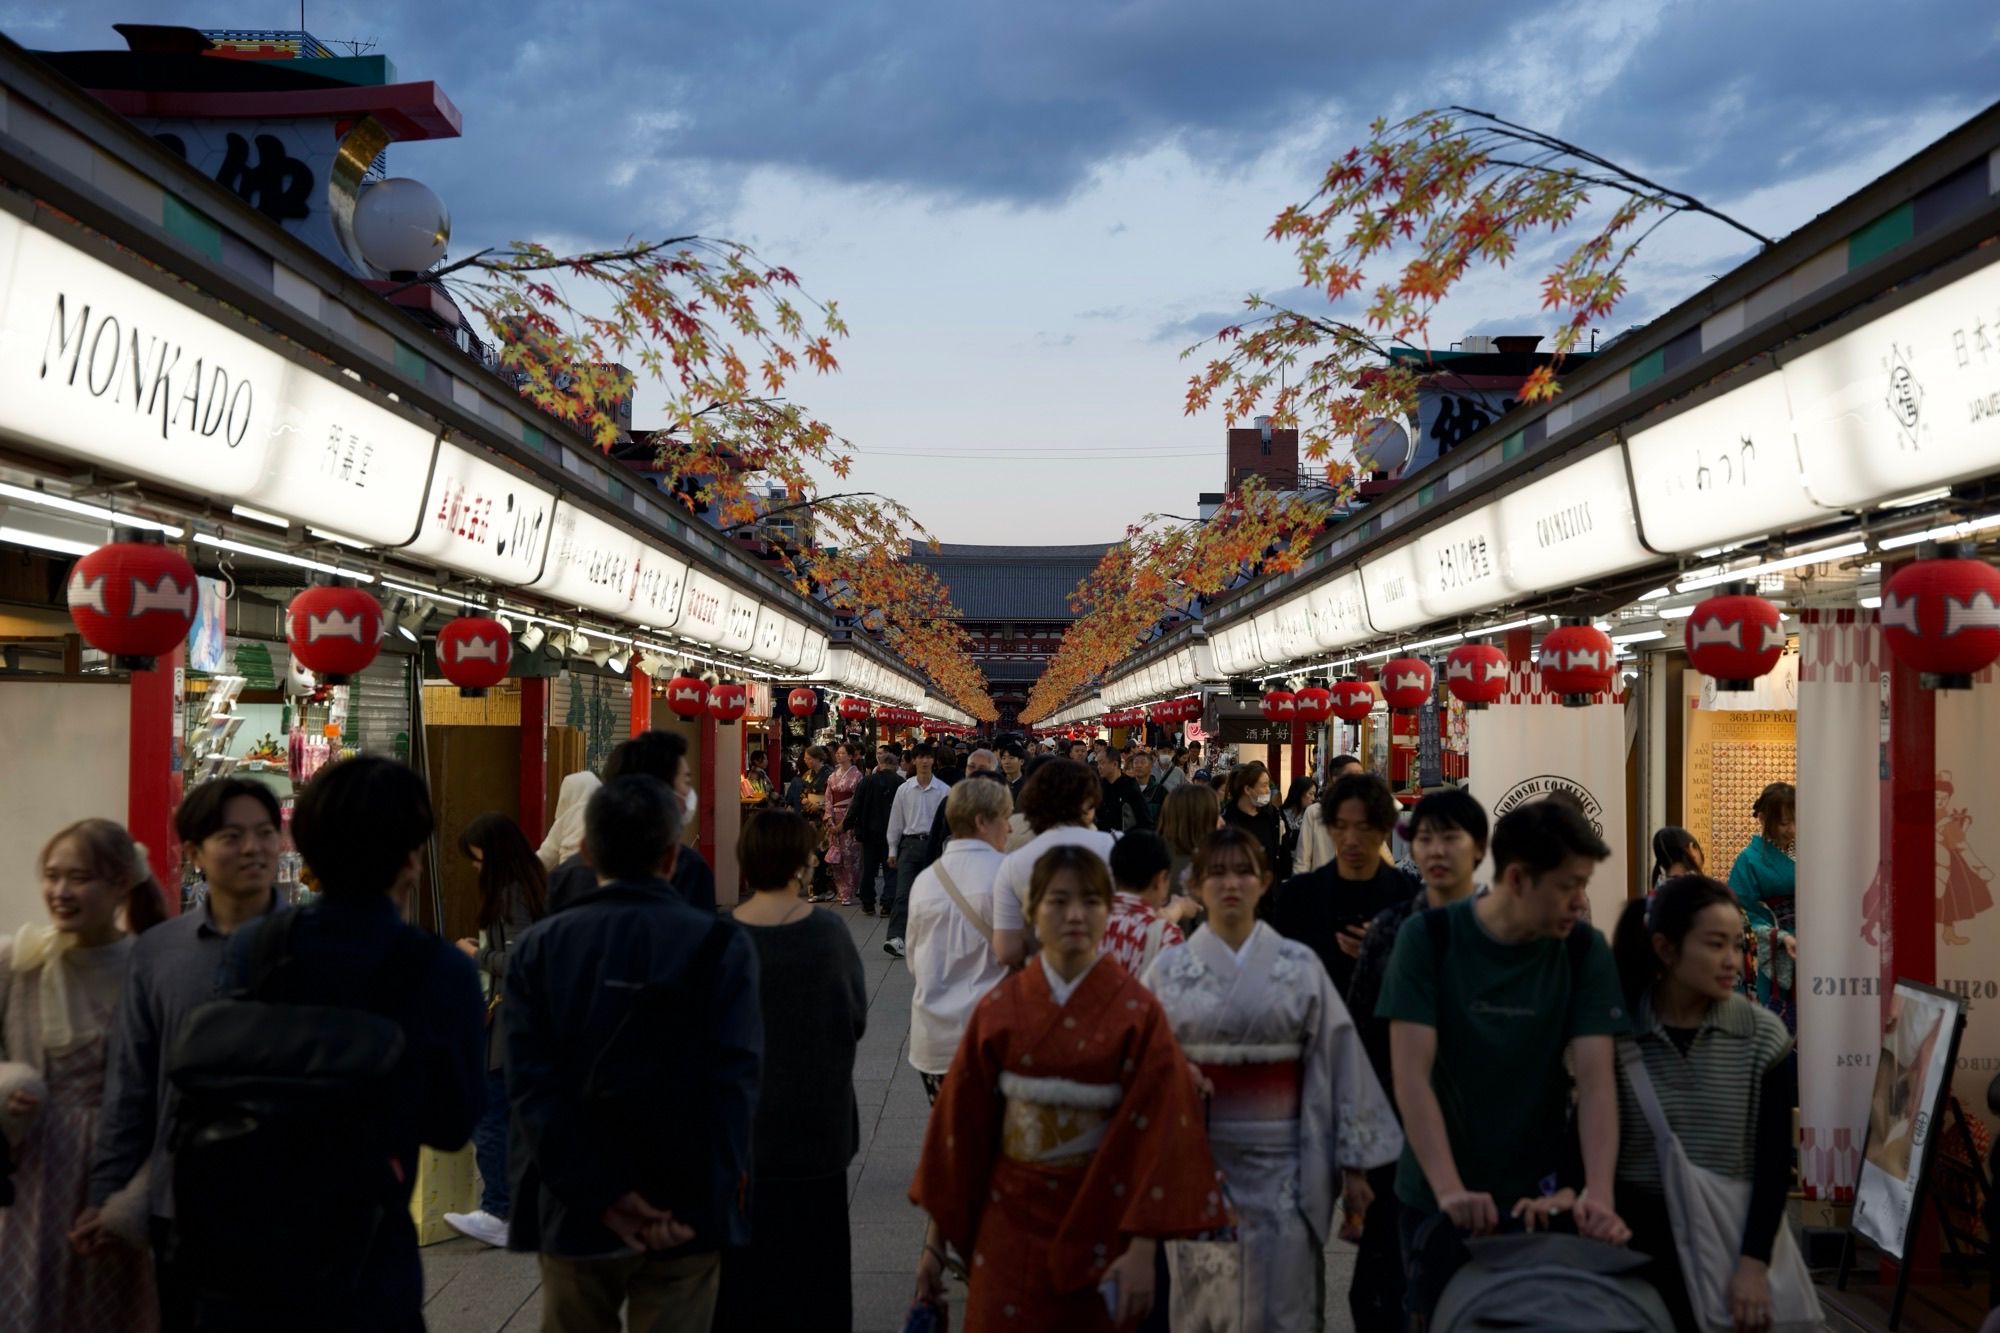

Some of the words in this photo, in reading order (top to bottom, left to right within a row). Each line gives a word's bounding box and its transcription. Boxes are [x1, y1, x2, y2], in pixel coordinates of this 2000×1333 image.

[1951, 306, 2000, 368] 日本
[40, 292, 254, 449] MONKADO
[1535, 500, 1594, 549] COSMETICS
[1245, 727, 1317, 741] 酒井好堂
[1729, 712, 1749, 722] 365
[1752, 713, 1770, 723] LIP
[1773, 713, 1797, 723] BAL
[1498, 781, 1541, 814] YOROSHI
